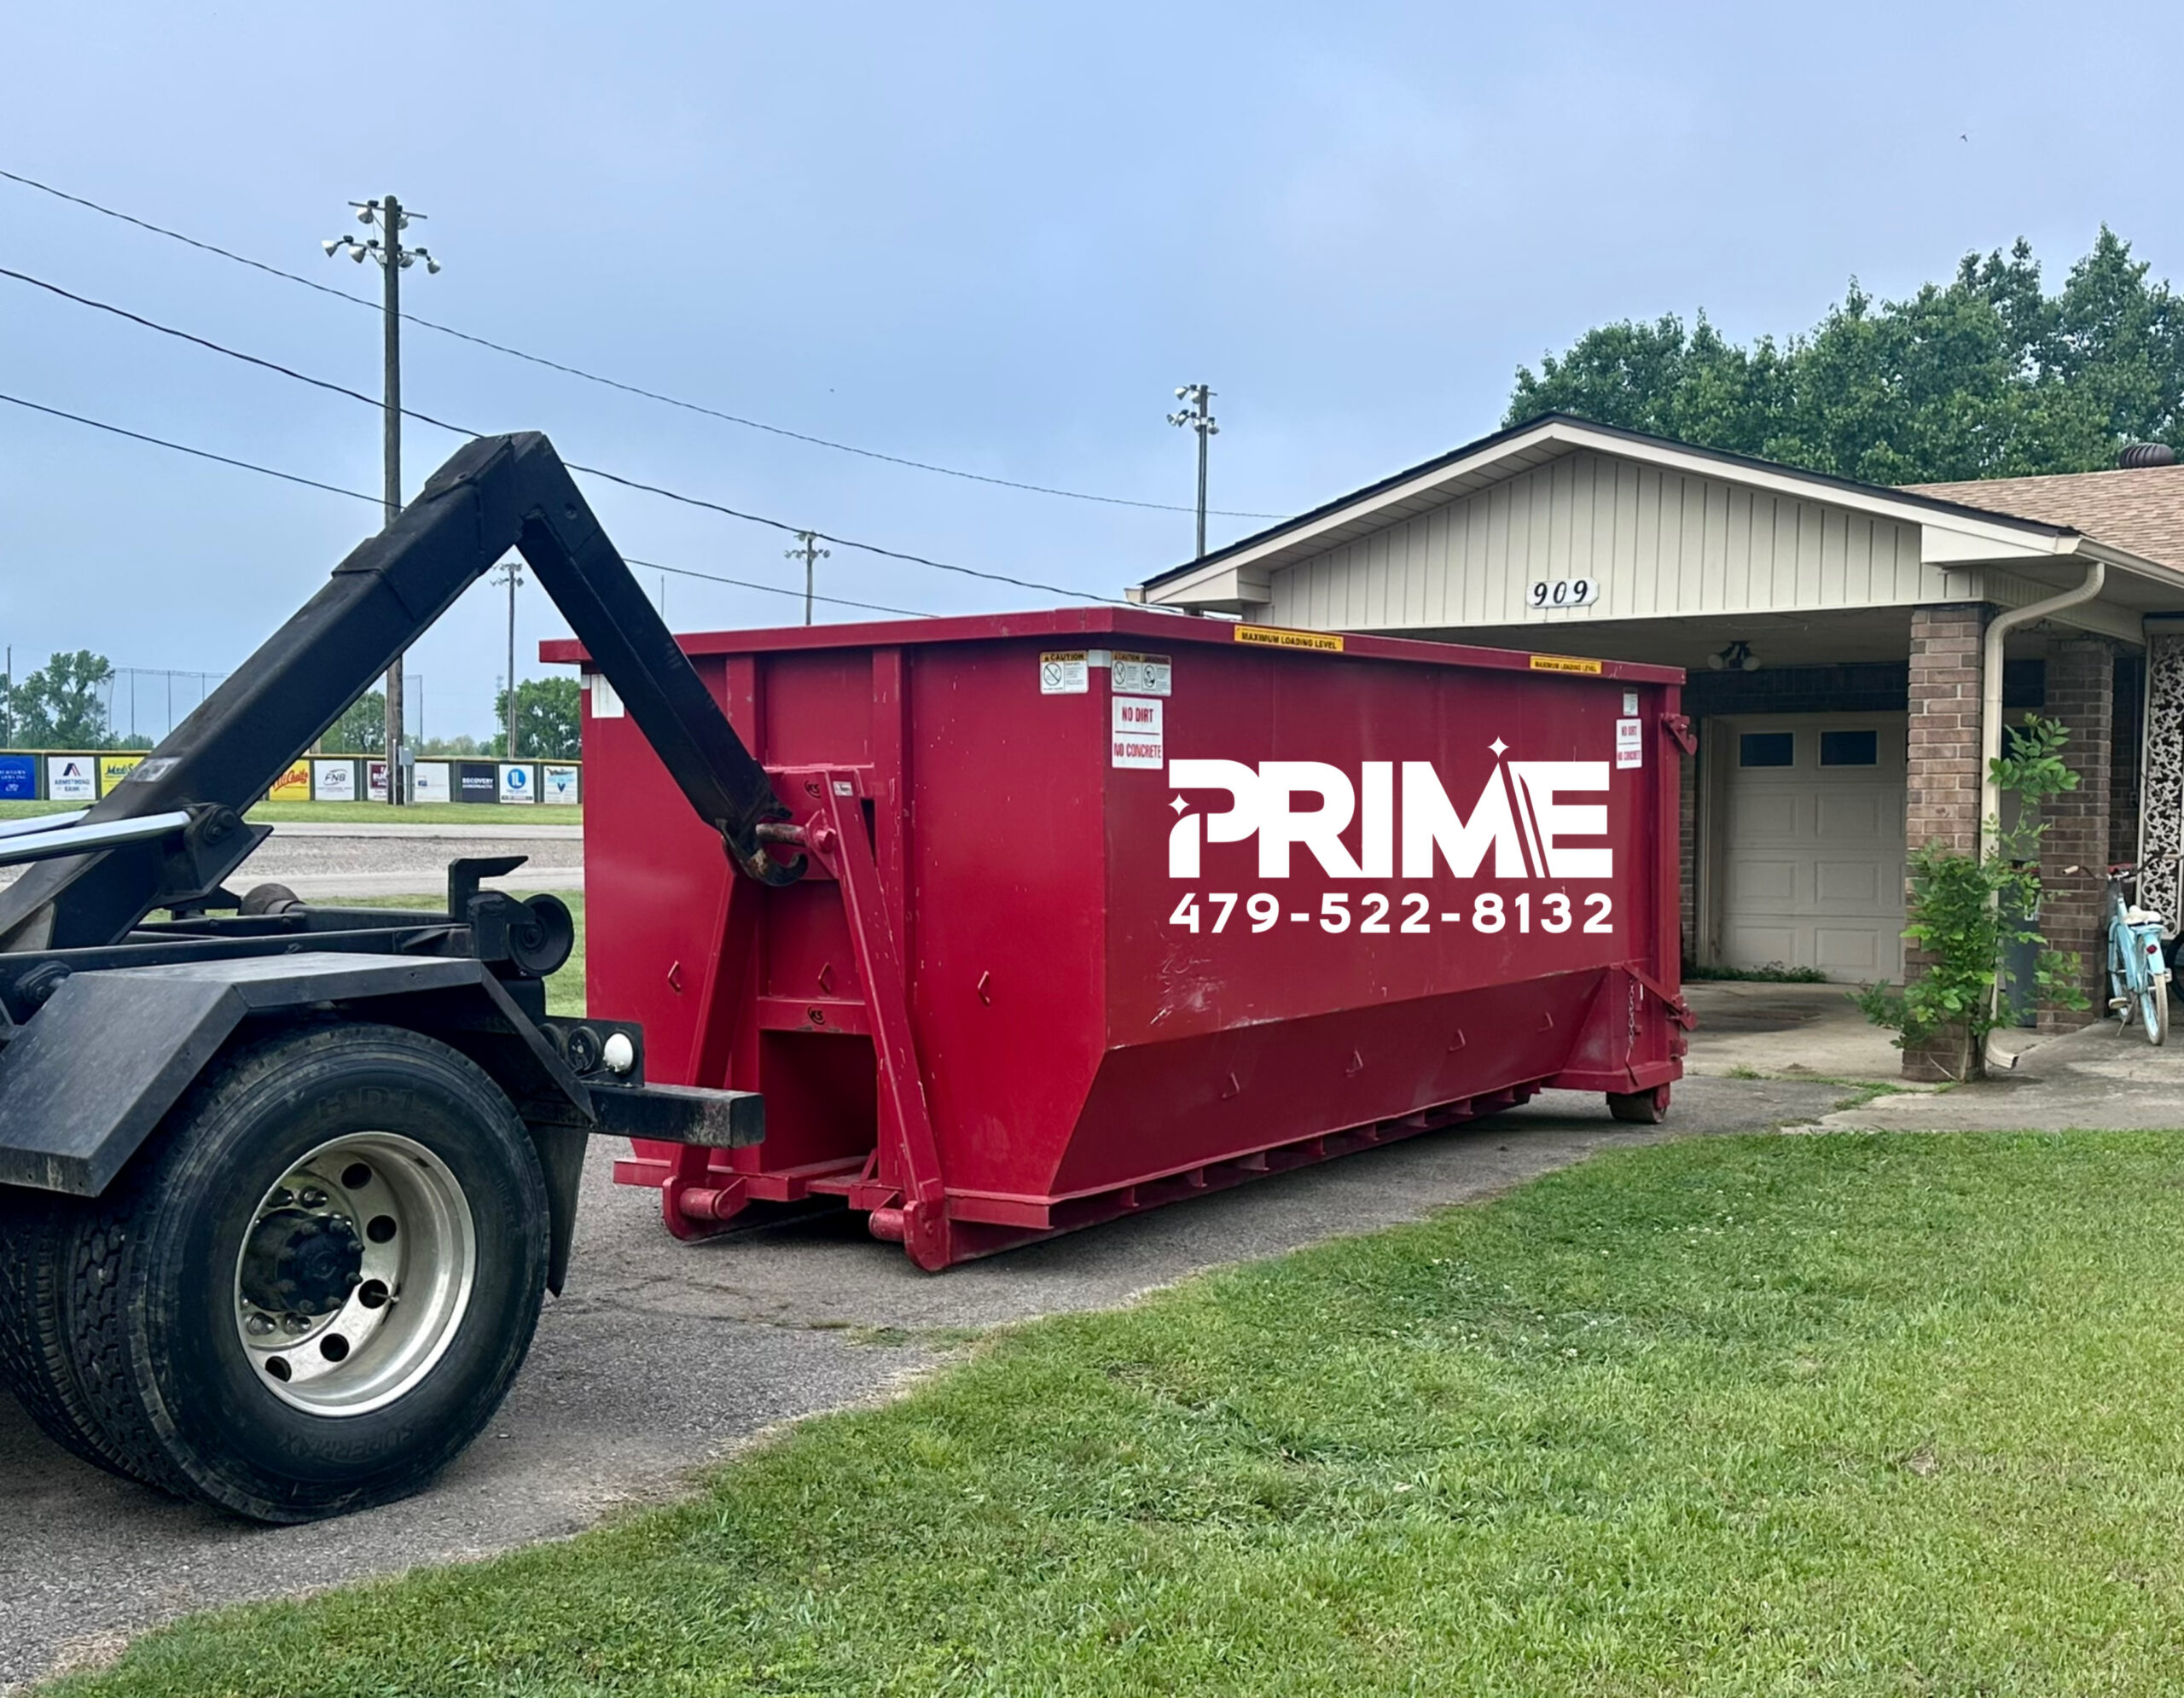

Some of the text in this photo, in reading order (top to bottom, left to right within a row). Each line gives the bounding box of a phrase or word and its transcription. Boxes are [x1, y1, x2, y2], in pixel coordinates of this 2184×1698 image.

[1533, 579, 1589, 606] 909
[1241, 631, 1338, 649] MAXIMUM LOADING LEVEL
[1050, 653, 1084, 661] CAUTION
[1122, 707, 1154, 723] NO DIRT
[1113, 743, 1162, 759] NO CONCRETE
[325, 773, 346, 782] FNB
